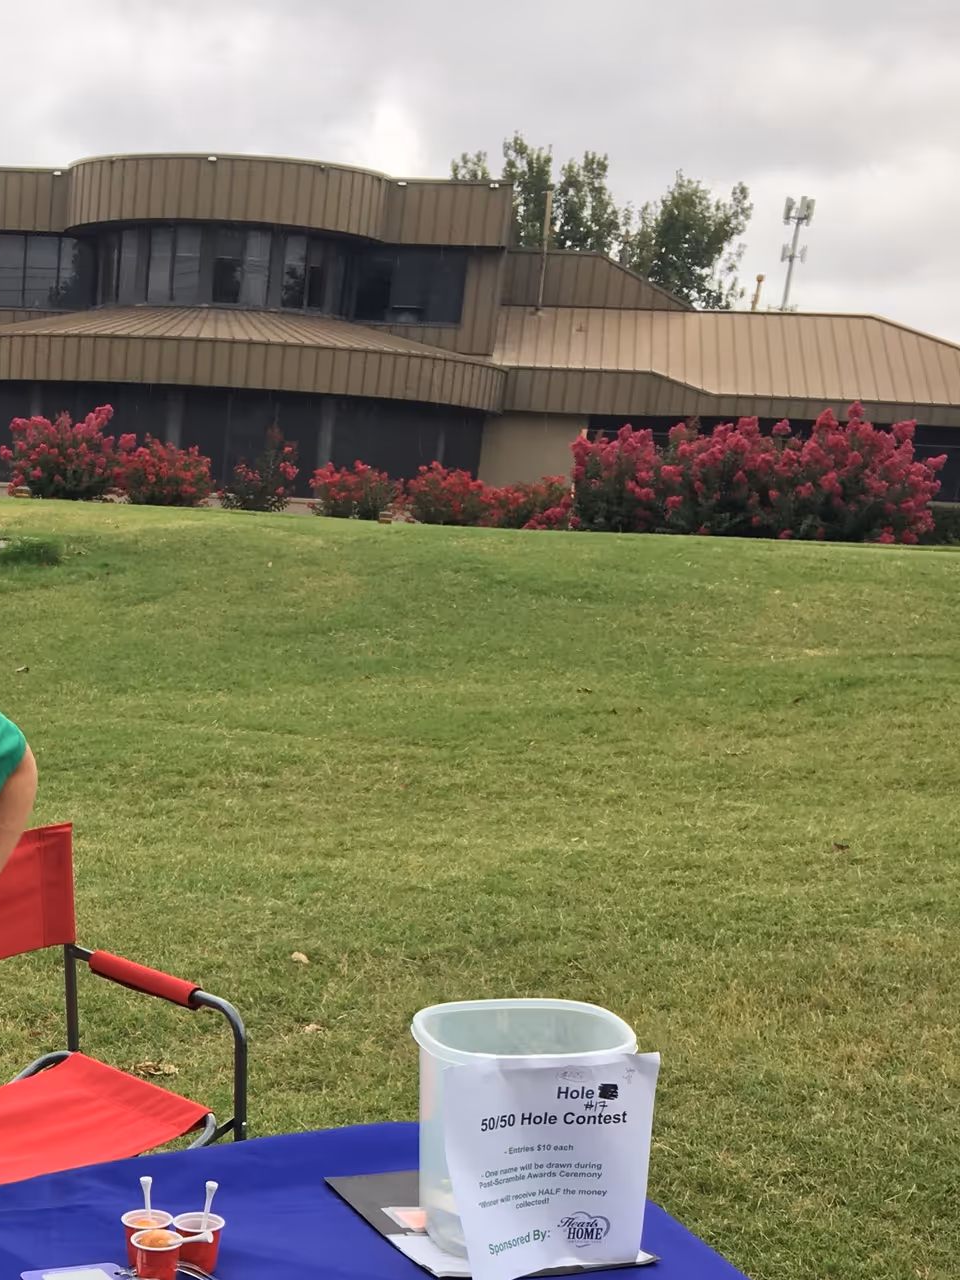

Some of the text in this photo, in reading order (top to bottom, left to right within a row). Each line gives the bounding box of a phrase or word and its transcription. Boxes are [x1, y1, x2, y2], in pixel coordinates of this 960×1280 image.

[556, 1086, 595, 1100] Hole
[583, 1100, 609, 1114] #17
[480, 1110, 628, 1132] 50/50 Hole Contest
[508, 1143, 574, 1155] Entries $10 each
[484, 1170, 499, 1179] One
[500, 1166, 518, 1175] name
[519, 1163, 533, 1172] will
[534, 1162, 544, 1170] be
[574, 1162, 603, 1171] during
[478, 1170, 603, 1190] Post-Scramble Awards Ceremony
[511, 1191, 537, 1201] receive
[538, 1188, 562, 1197] HALF
[562, 1187, 576, 1195] the
[578, 1189, 608, 1197] money
[567, 1227, 603, 1240] HOME
[488, 1229, 551, 1256] Sponsored By:
